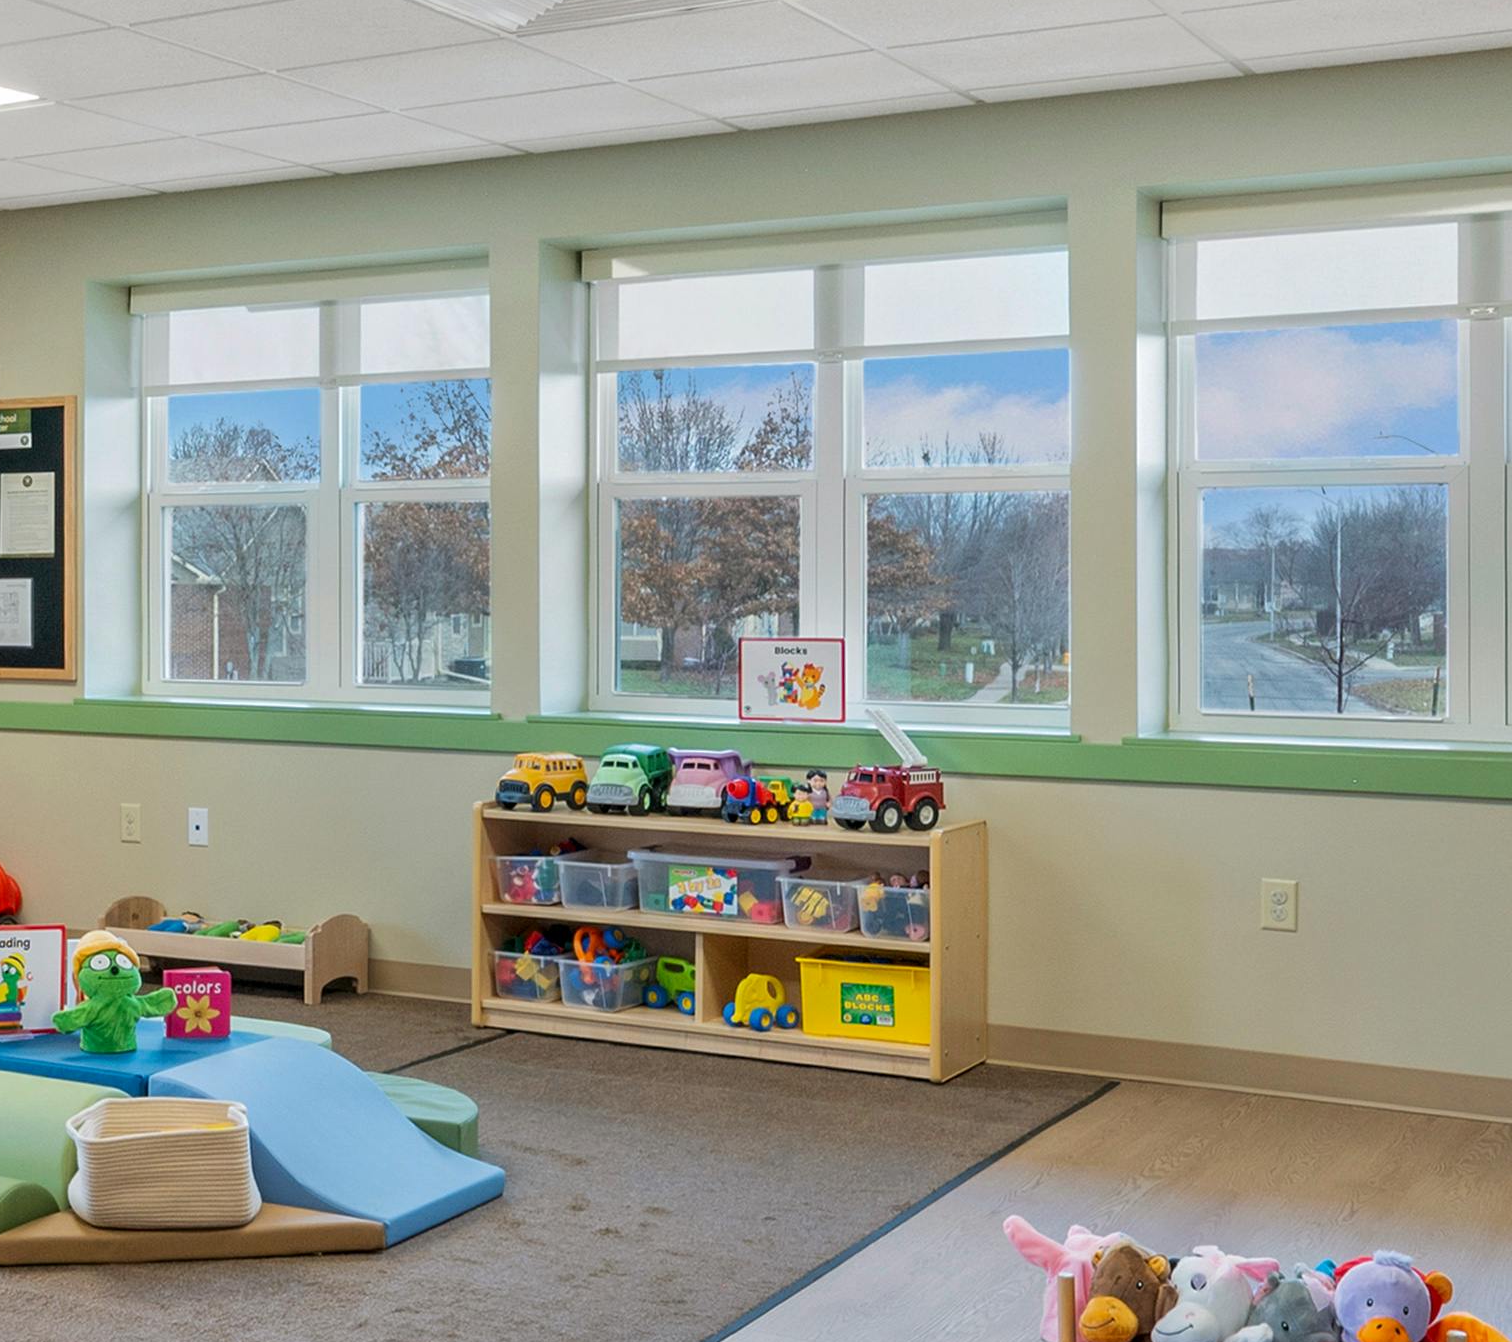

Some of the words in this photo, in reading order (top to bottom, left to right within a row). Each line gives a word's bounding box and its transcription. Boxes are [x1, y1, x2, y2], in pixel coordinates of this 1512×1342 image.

[774, 646, 808, 655] Blocks
[175, 980, 222, 994] colors
[855, 993, 880, 1002] ABC
[844, 1000, 892, 1012] BLOCKS
